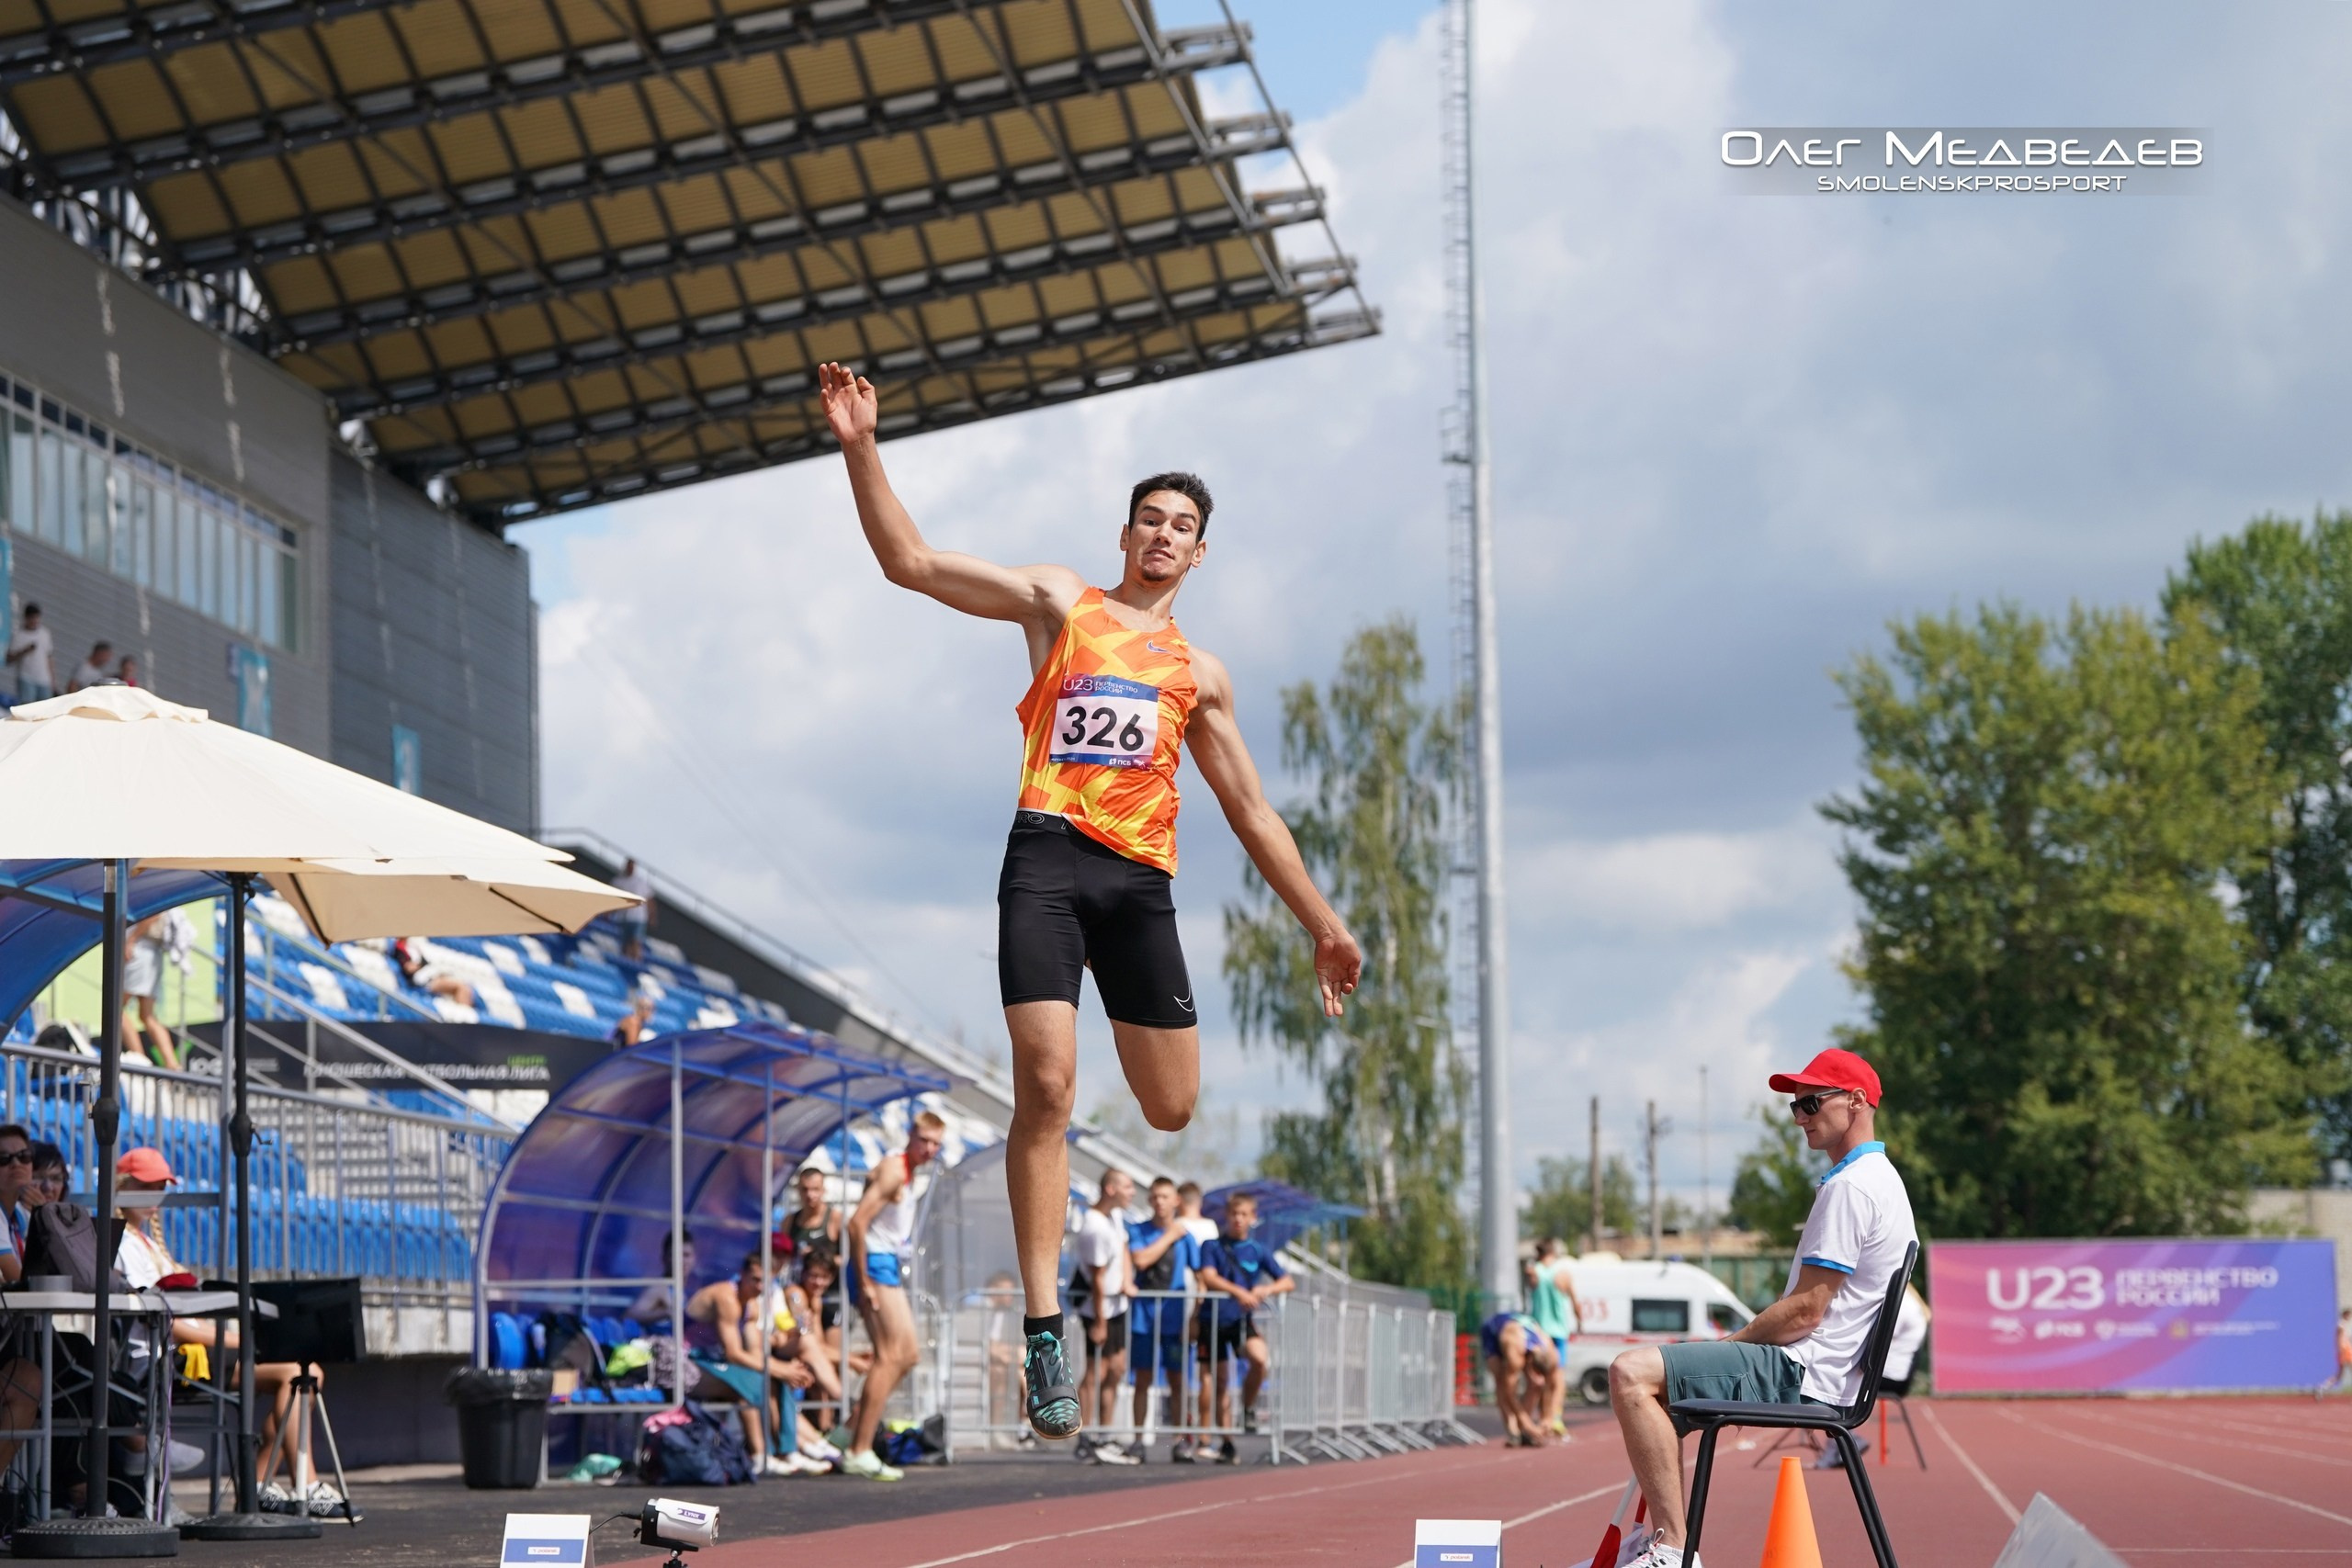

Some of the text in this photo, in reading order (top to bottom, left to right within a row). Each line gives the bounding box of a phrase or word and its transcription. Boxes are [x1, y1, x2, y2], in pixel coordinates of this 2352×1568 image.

[1062, 679, 1093, 691] U23
[1094, 685, 1123, 694] РОССИИ
[1095, 681, 1138, 694] ПЕРВЕНСТВО
[1062, 705, 1144, 751] 326
[2115, 1266, 2278, 1288] ПЕРВЕНСТВО
[1985, 1265, 2105, 1310] U23
[2115, 1287, 2220, 1307] РОССИИ
